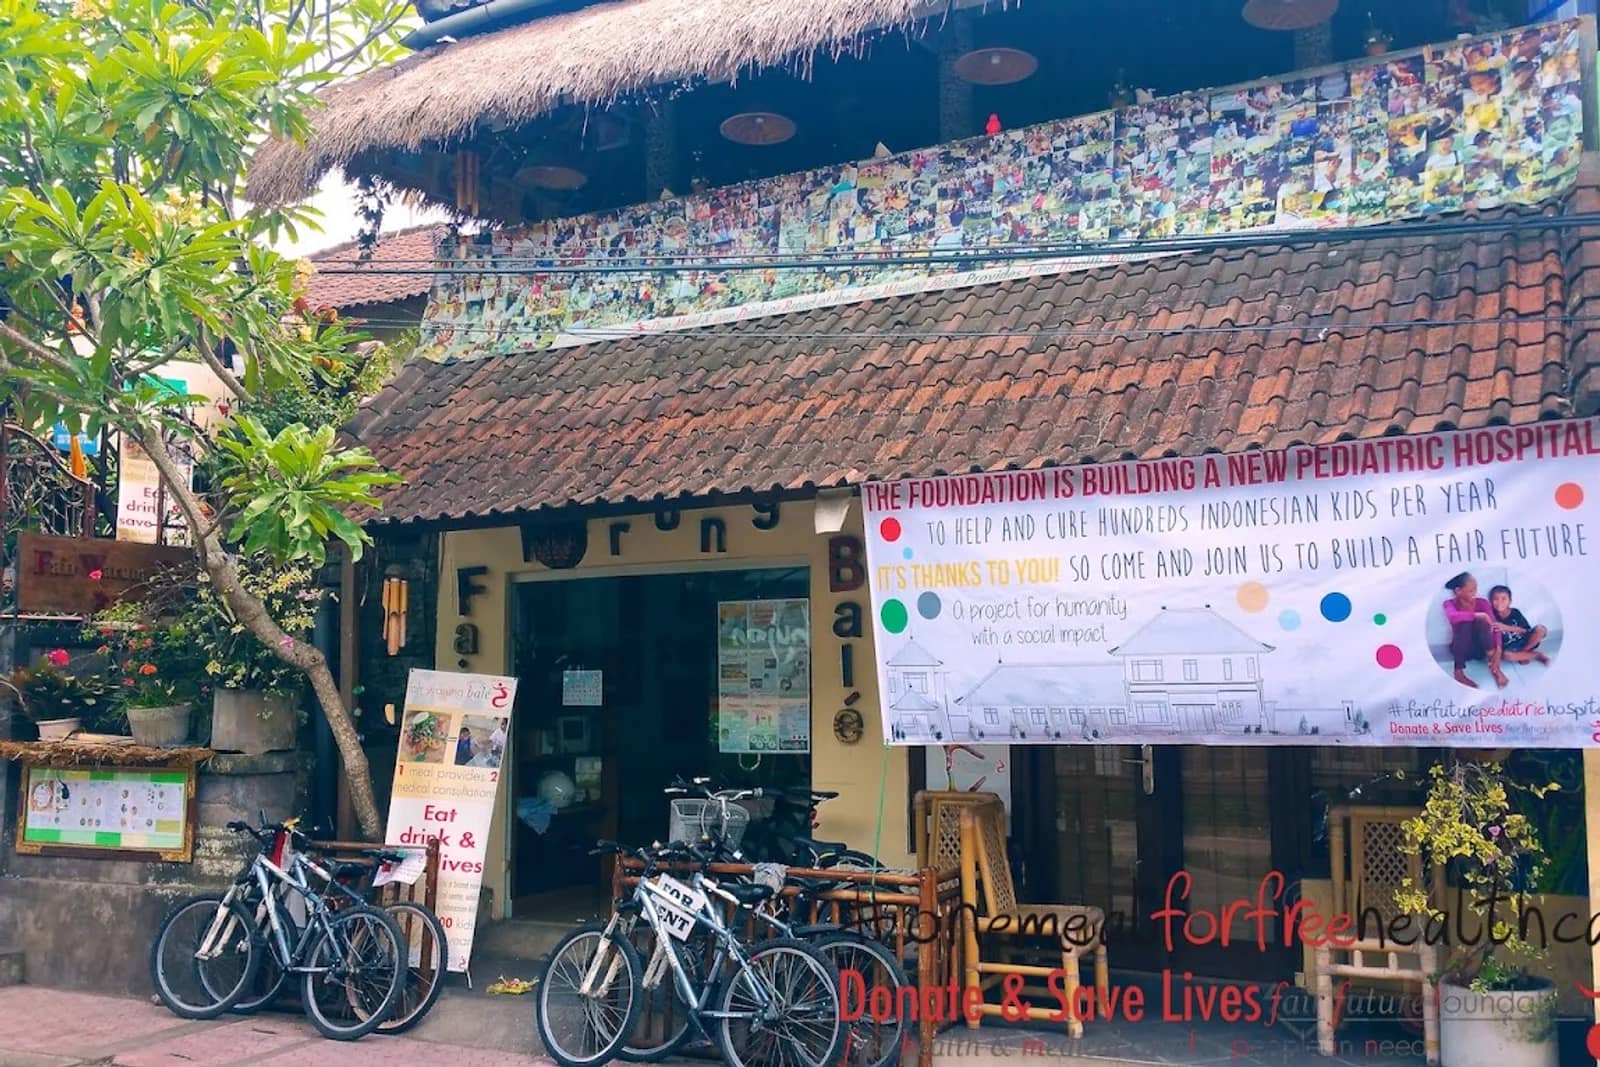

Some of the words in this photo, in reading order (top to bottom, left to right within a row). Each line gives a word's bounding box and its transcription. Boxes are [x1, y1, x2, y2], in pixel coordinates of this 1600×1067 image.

[864, 482, 901, 512] THE
[908, 473, 1047, 509] FOUNDATION
[1053, 470, 1075, 499] IS
[1082, 459, 1196, 497] BUILDING
[1204, 457, 1221, 486] A
[1227, 450, 1287, 488] NEW
[1297, 436, 1445, 480] PEDIATRIC
[1453, 420, 1600, 468] HOSPITAL
[928, 521, 945, 546] TO
[955, 514, 992, 545] HELP
[1002, 512, 1035, 543] AND
[1045, 509, 1088, 540] CURE
[1099, 504, 1189, 536] HUNDREDS
[1201, 493, 1319, 531] INDONESIAN
[1331, 487, 1378, 522] KIDS
[1390, 482, 1427, 517] PER
[1440, 477, 1498, 514] YEAR
[876, 564, 906, 592] IT'S
[911, 559, 983, 591] THANKS
[987, 558, 1010, 585] TO
[1016, 556, 1060, 584] YOU!
[1070, 554, 1089, 583] SO
[1100, 550, 1145, 580] COME
[1157, 547, 1193, 578] AND
[1204, 543, 1248, 576] JOIN
[1260, 543, 1284, 573] US
[1296, 541, 1319, 571] TO
[1331, 535, 1394, 570] BUILD
[1408, 534, 1421, 566] A
[1435, 528, 1487, 564] FAIR
[1502, 523, 1588, 561] FUTURE
[969, 598, 1020, 624] project
[1028, 595, 1050, 618] for
[1055, 593, 1127, 621] humanity
[972, 626, 998, 646] with
[1003, 631, 1013, 645] a
[1017, 625, 1056, 645] social
[1060, 623, 1107, 647] impact
[1390, 721, 1429, 735] Donate
[1432, 722, 1441, 735] &
[1445, 721, 1472, 735] Save
[1475, 718, 1503, 735] Lives
[490, 771, 498, 783] 2
[424, 804, 459, 823] Eat
[459, 831, 476, 849] &
[657, 902, 690, 932] ENT
